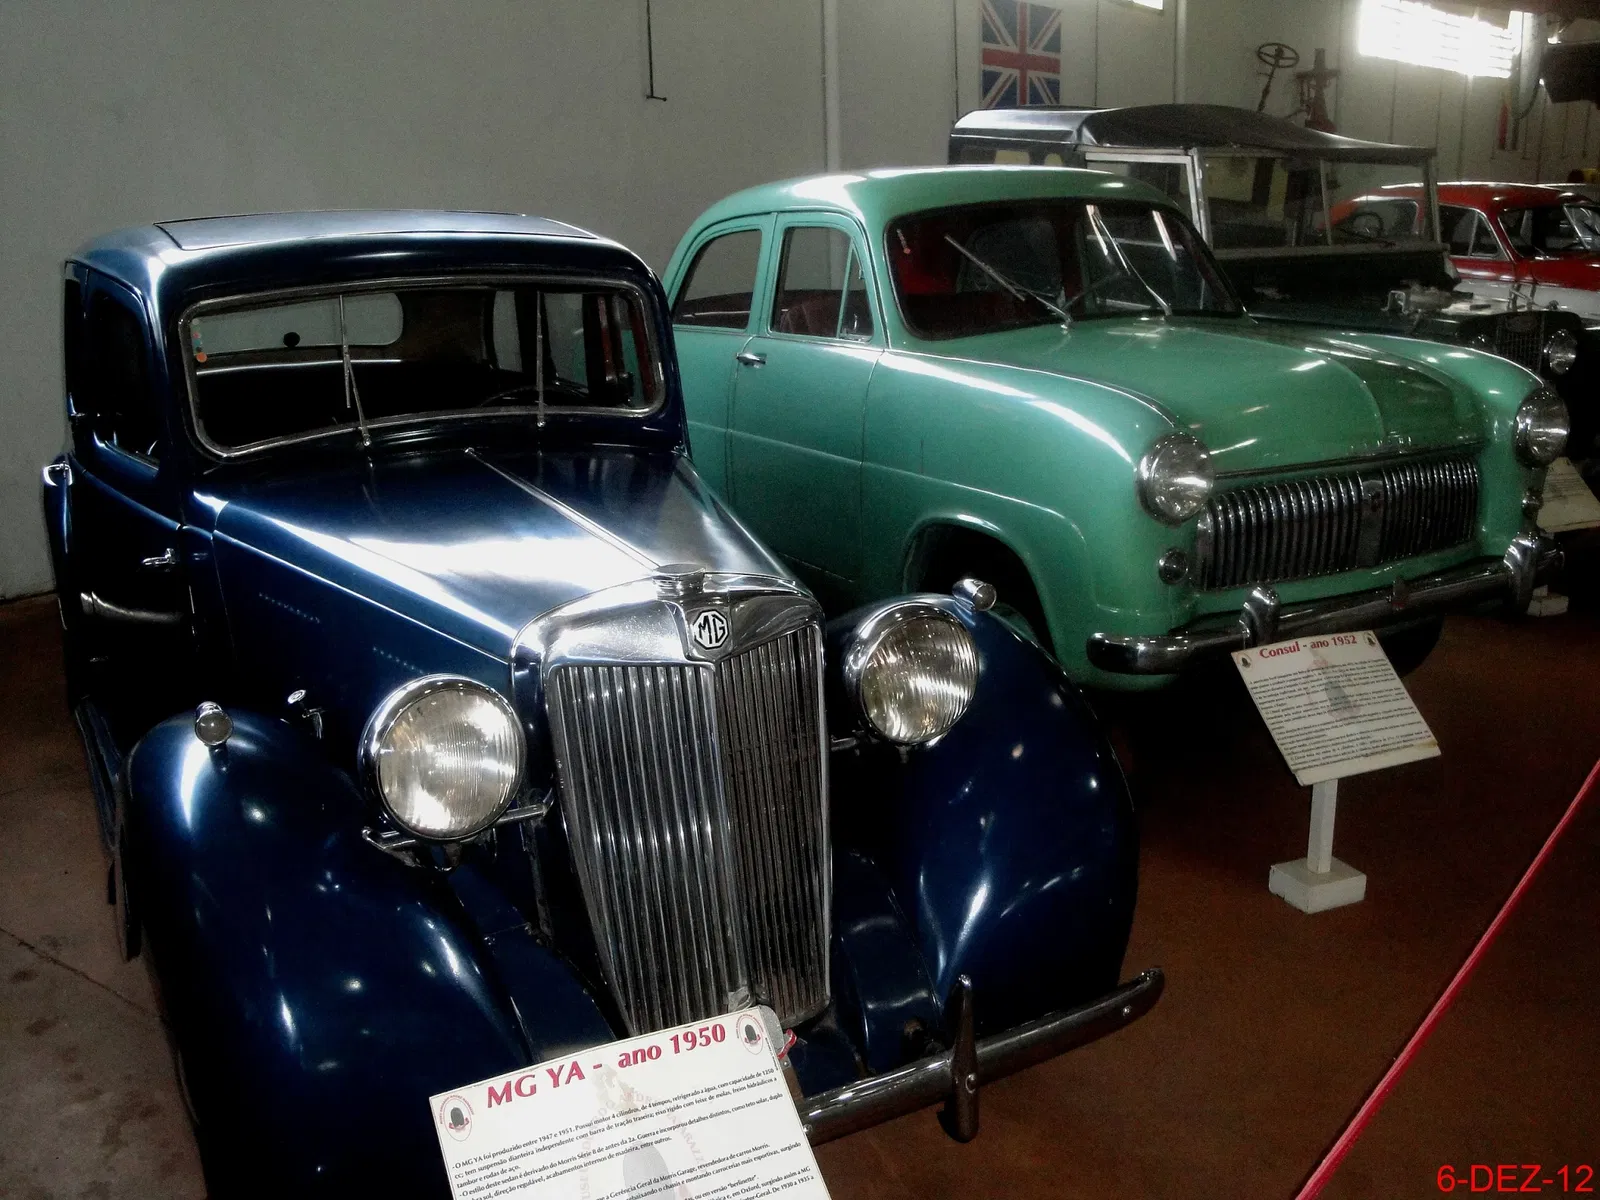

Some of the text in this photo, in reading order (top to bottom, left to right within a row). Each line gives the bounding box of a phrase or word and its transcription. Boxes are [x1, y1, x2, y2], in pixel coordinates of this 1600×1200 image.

[1260, 641, 1300, 659] Consul
[1310, 639, 1330, 649] ano
[1333, 635, 1357, 647] 1952
[487, 1074, 537, 1108] MG
[546, 1061, 586, 1088] YA
[618, 1045, 662, 1068] ano
[669, 1024, 726, 1056] 1950
[462, 1158, 473, 1166] MG
[483, 1152, 491, 1160] foi
[492, 1144, 522, 1158] produzido
[522, 1139, 538, 1147] entre
[538, 1133, 552, 1142] 1947
[558, 1127, 574, 1136] 1951.
[593, 1116, 610, 1124] motor
[616, 1108, 641, 1117] cilindros,
[652, 1099, 672, 1107] tempos,
[672, 1090, 700, 1101] refrigerado
[728, 1074, 755, 1085] capacidade
[464, 1168, 476, 1176] tem
[478, 1159, 507, 1171] suspensão
[508, 1150, 534, 1162] dianteira
[535, 1138, 574, 1153] independente
[589, 1128, 605, 1136] barra
[614, 1118, 632, 1127] tração
[633, 1113, 654, 1122] traseira;
[746, 1078, 773, 1088] hidráulicos
[469, 1186, 485, 1194] estilo
[485, 1181, 500, 1189] deste
[501, 1175, 518, 1184] sedan
[523, 1165, 549, 1177] derivado
[557, 1156, 577, 1165] Morris
[577, 1151, 591, 1159] Série
[605, 1142, 620, 1150] antes
[637, 1132, 655, 1140] Guerra
[659, 1122, 688, 1133] incorporou
[688, 1116, 708, 1125] detalhes
[708, 1110, 731, 1118] distintos,
[731, 1104, 745, 1112] como
[483, 1192, 493, 1200] sol,
[494, 1186, 516, 1196] direção
[516, 1176, 545, 1189] regulável,
[546, 1164, 583, 1179] acabamentos
[583, 1156, 607, 1167] internos
[615, 1146, 640, 1156] madeira,
[640, 1141, 653, 1149] entre
[609, 1185, 636, 1198] Gerência
[636, 1178, 652, 1189] Geral
[659, 1173, 677, 1181] Morris
[676, 1167, 697, 1176] Garage,
[697, 1157, 729, 1169] revendedora
[735, 1149, 752, 1157] carros
[752, 1143, 770, 1152] Morris.
[662, 1181, 680, 1190] chassis
[685, 1171, 711, 1183] montando
[712, 1162, 740, 1174] carrocerias
[741, 1157, 753, 1165] mais
[753, 1150, 780, 1161] esportivas,
[780, 1142, 801, 1152] surgindo
[456, 1178, 478, 1188] tambor
[483, 1171, 499, 1180] rodas
[710, 1186, 727, 1194] versão
[740, 1183, 761, 1194] Oxford,
[761, 1176, 783, 1187] surgindo
[780, 1181, 793, 1189] 1930
[797, 1175, 810, 1184] 1935
